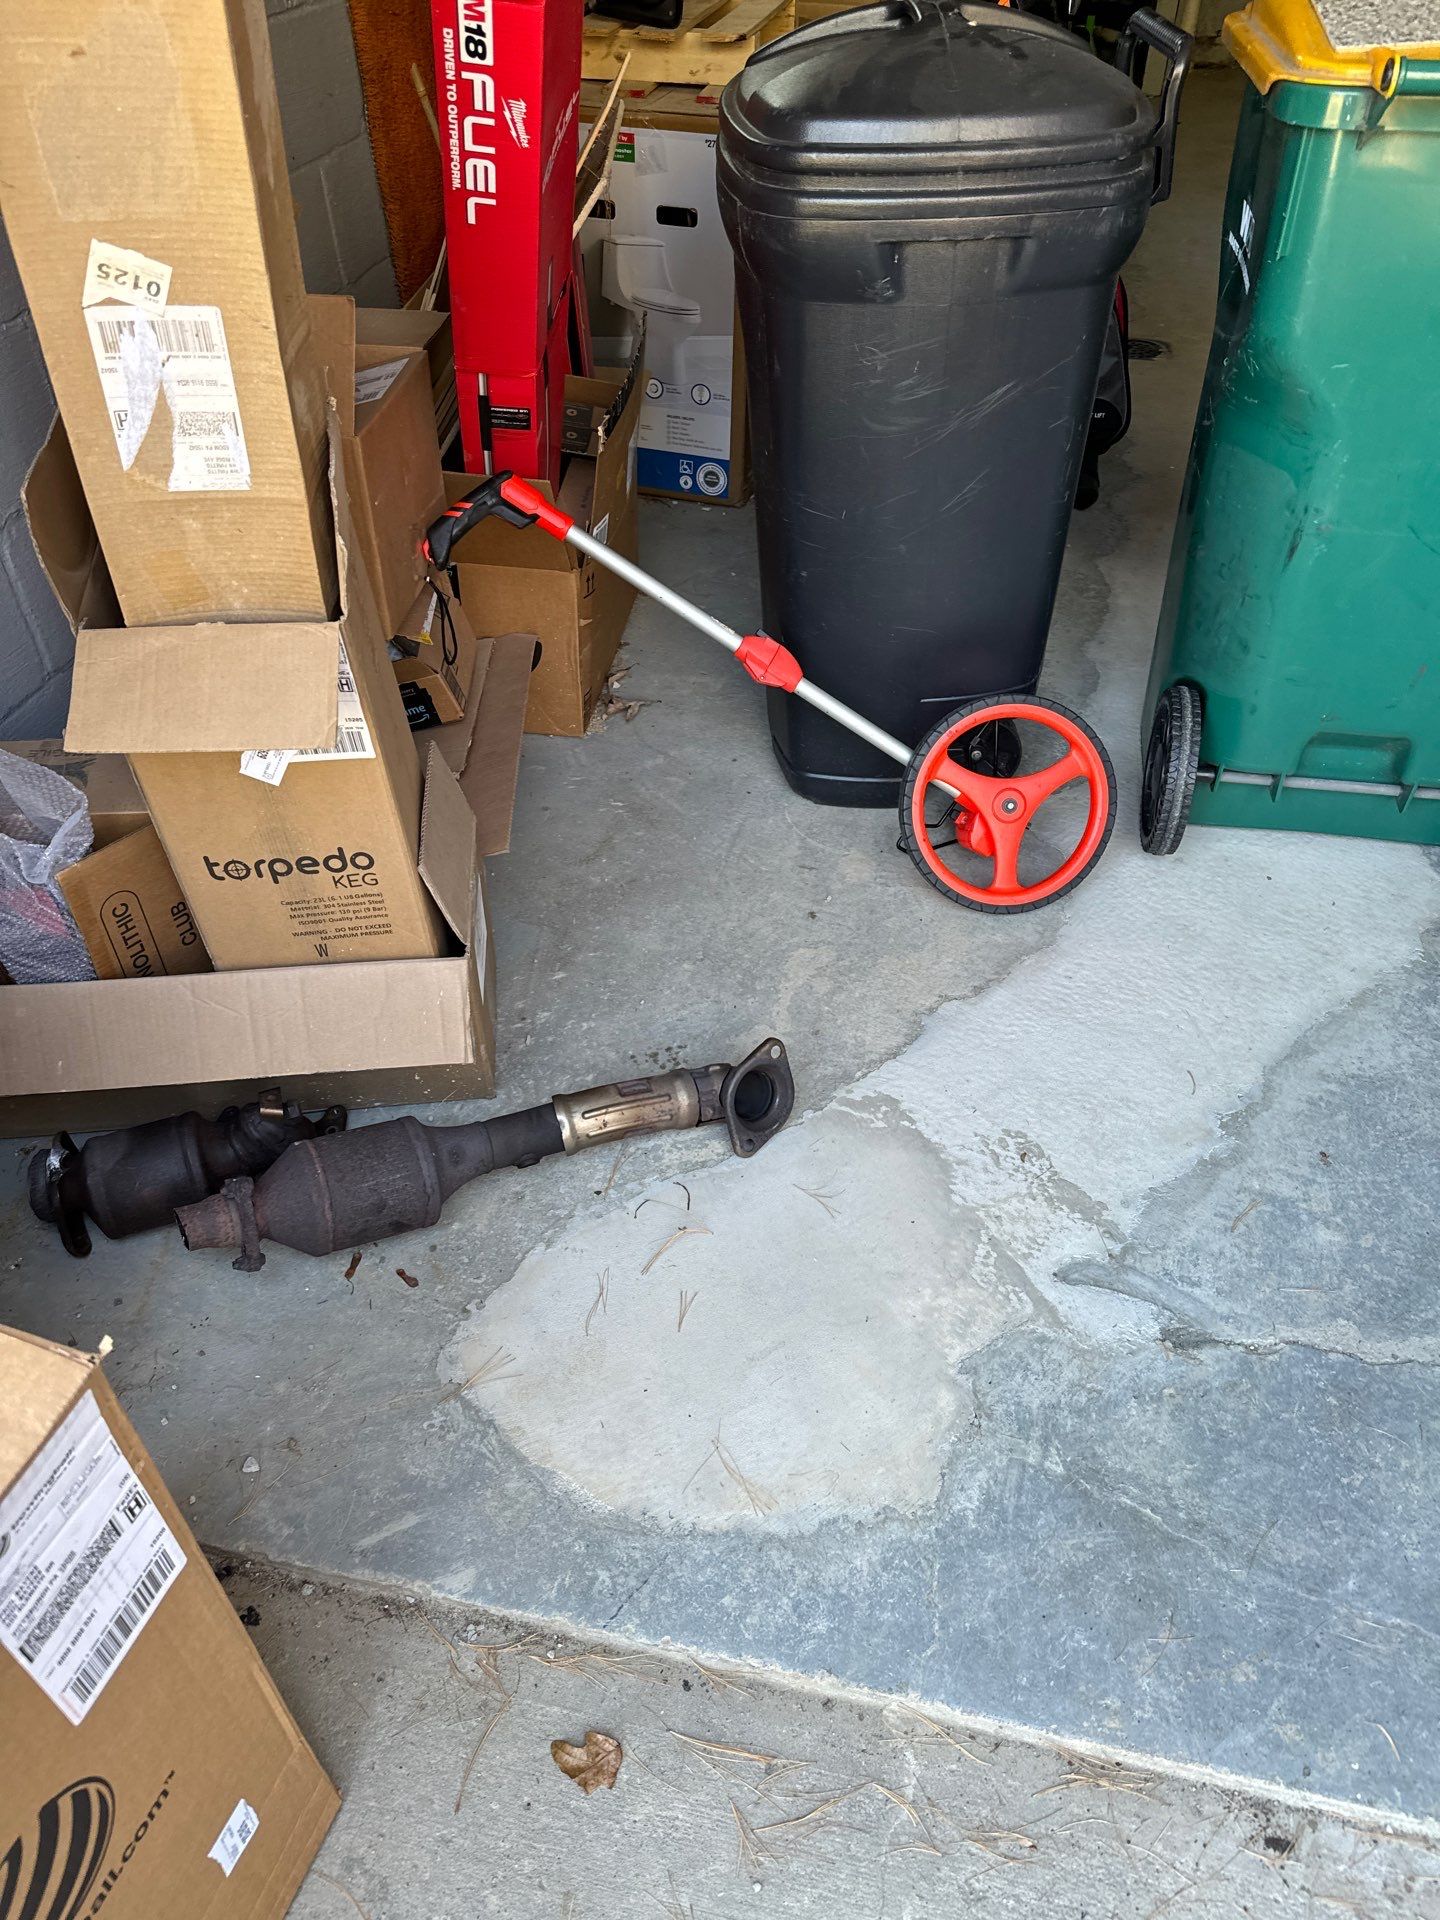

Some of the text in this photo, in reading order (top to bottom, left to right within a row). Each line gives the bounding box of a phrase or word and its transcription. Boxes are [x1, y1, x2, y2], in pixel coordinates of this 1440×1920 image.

[443, 27, 461, 191] DRIVEN TO OUTPERFORM.
[461, 0, 497, 225] M18 FUEL
[508, 97, 530, 149] Milwaukee
[97, 262, 161, 298] 0125
[203, 846, 375, 885] torpedo
[332, 872, 379, 889] KEG
[170, 901, 197, 947] CLUB
[291, 929, 328, 937] WARNING
[320, 929, 393, 941] MAXIMUM PRESSURE
[314, 943, 329, 957] W
